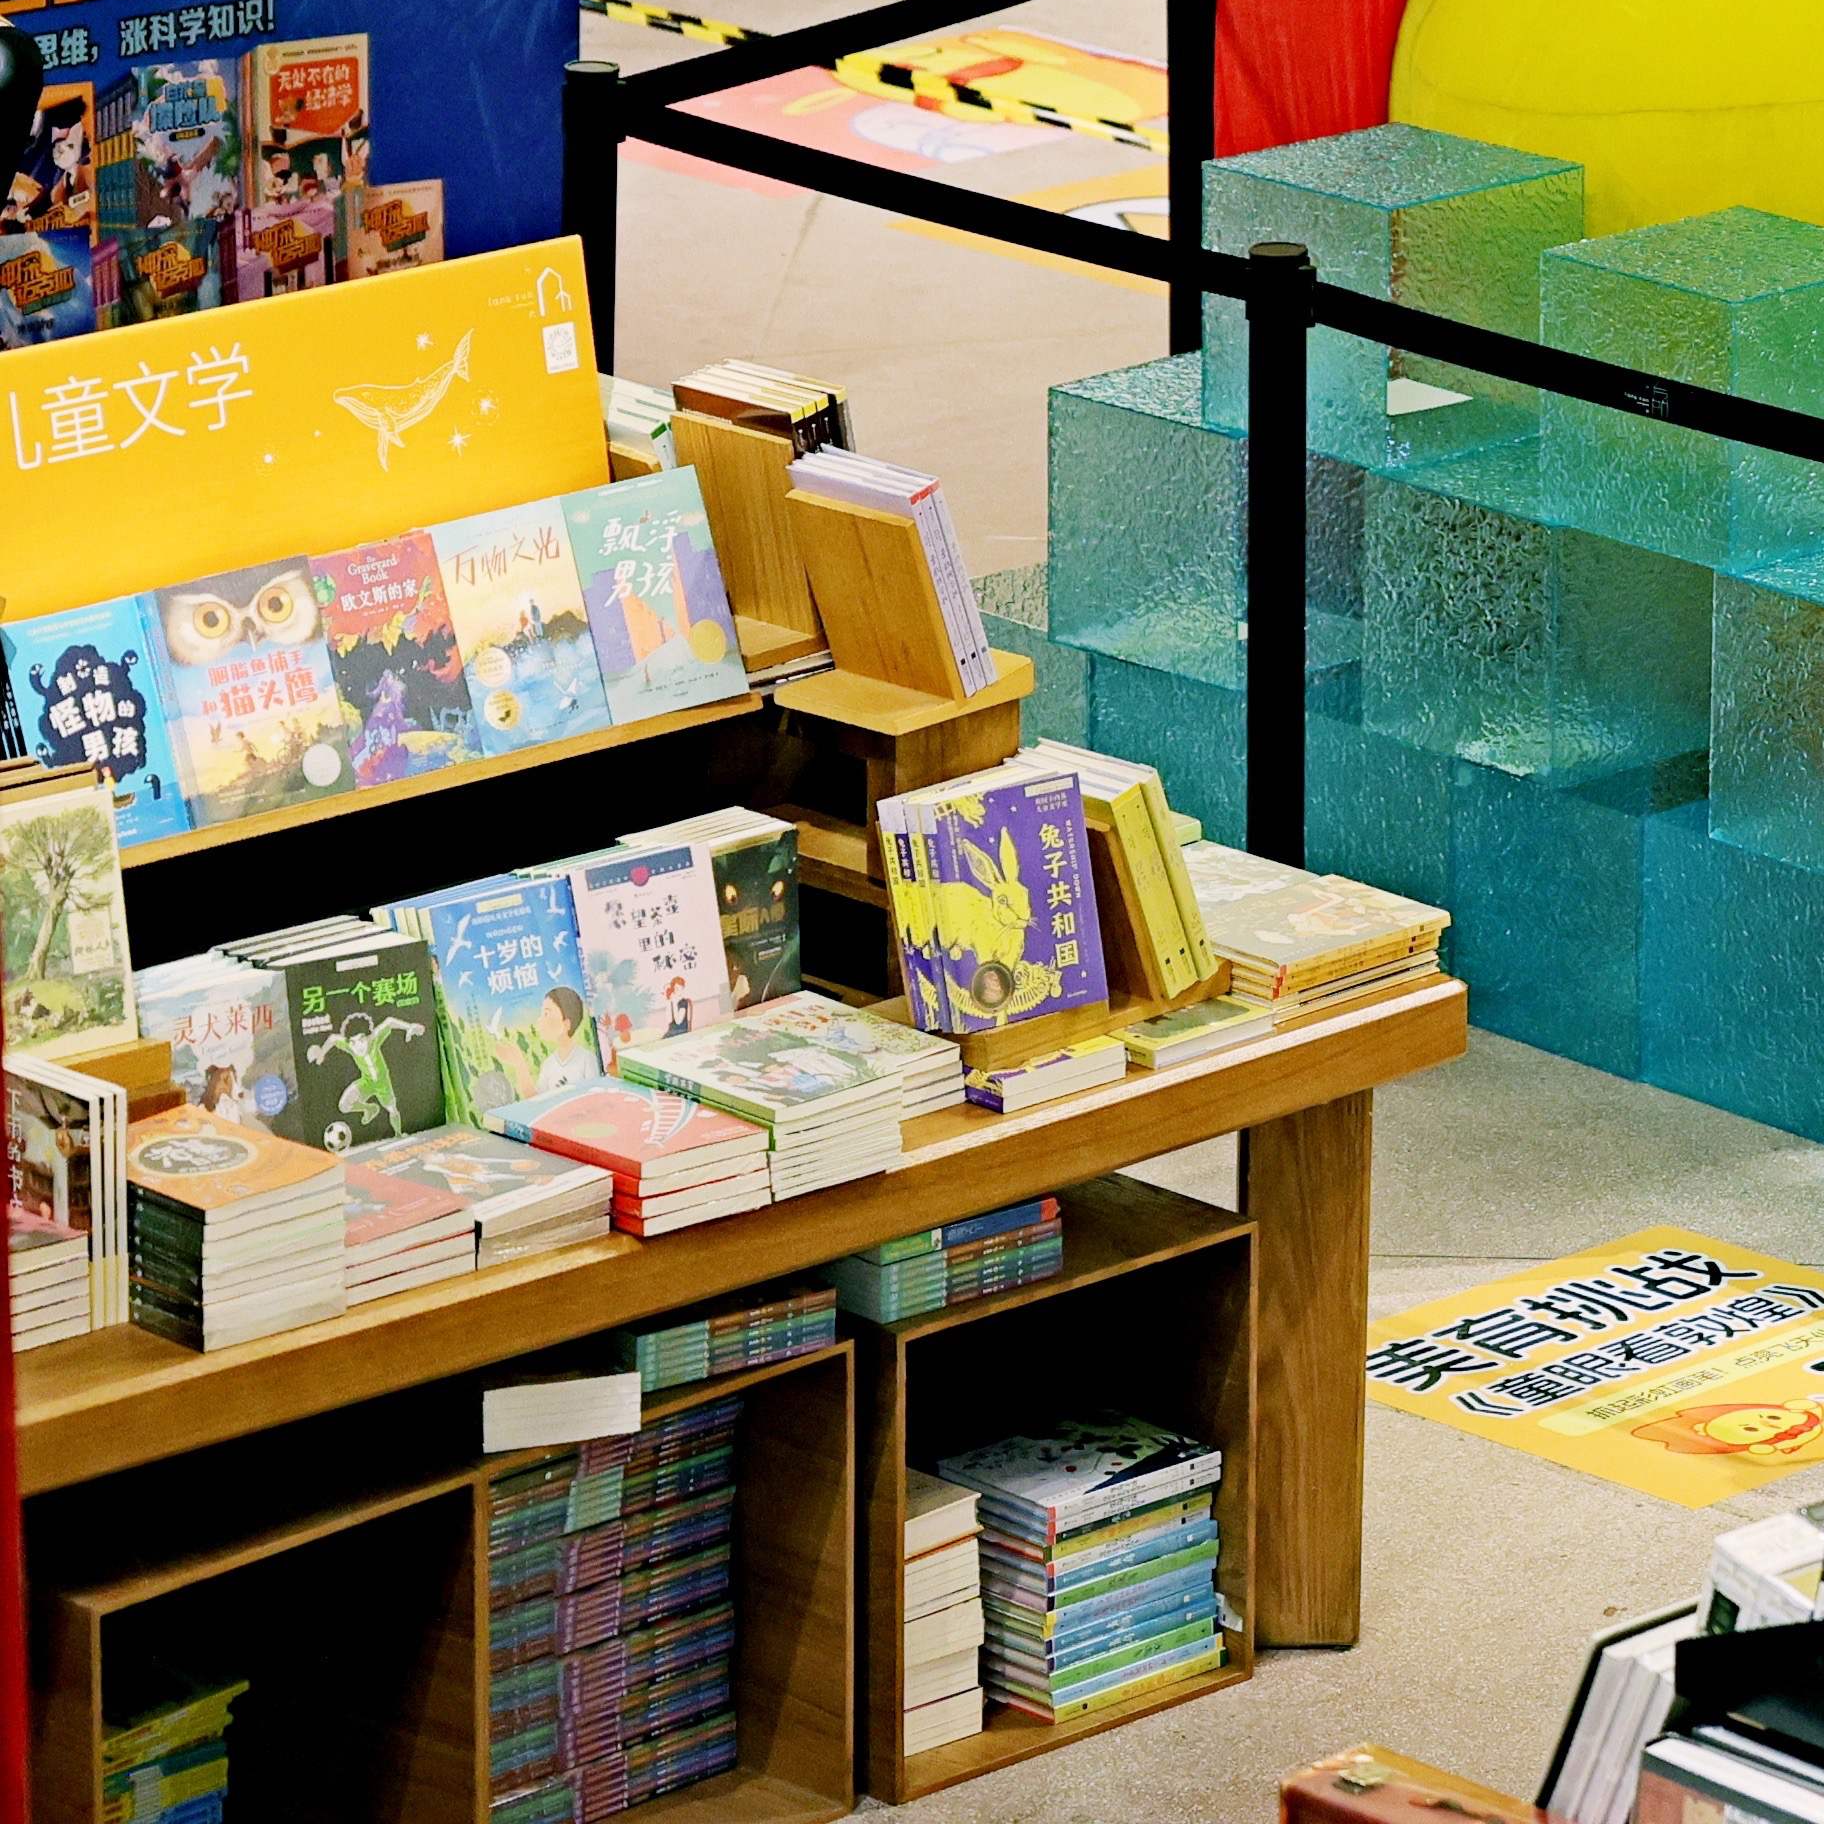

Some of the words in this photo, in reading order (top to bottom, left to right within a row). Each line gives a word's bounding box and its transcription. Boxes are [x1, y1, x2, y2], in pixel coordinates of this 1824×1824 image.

[599, 509, 682, 558] 飘浮
[362, 569, 390, 585] Book
[443, 526, 561, 587] 万物之光
[49, 687, 136, 740] 怪物的
[81, 725, 140, 764] 男孩
[1037, 823, 1082, 971] 兔子共和国
[473, 933, 544, 969] 十岁的
[302, 971, 419, 1016] 另一个赛场
[487, 962, 540, 997] 烦恼
[173, 1003, 274, 1045] 灵犬莱西
[1366, 1249, 1758, 1393] 美育挑战
